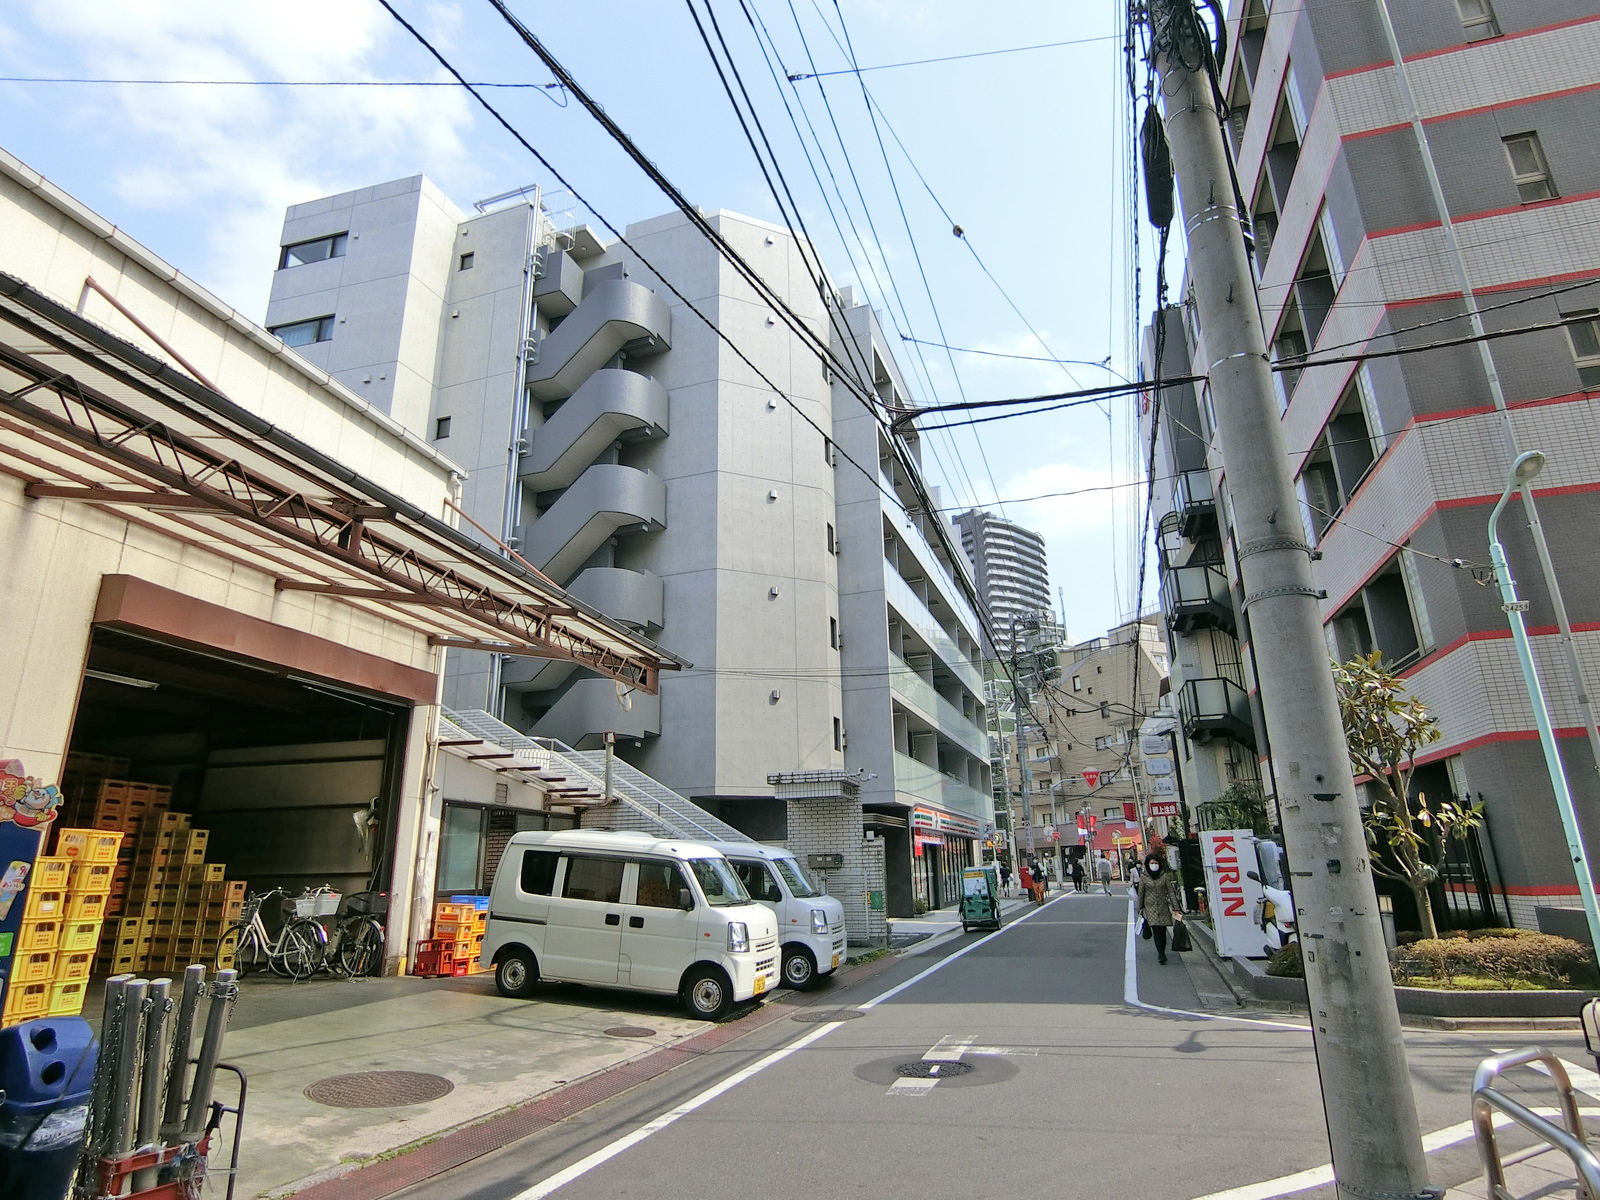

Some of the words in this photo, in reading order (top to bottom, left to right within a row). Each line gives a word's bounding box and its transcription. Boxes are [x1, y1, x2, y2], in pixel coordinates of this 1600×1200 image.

[1152, 805, 1176, 815] 頭上注意
[1212, 836, 1247, 917] KIRIN
